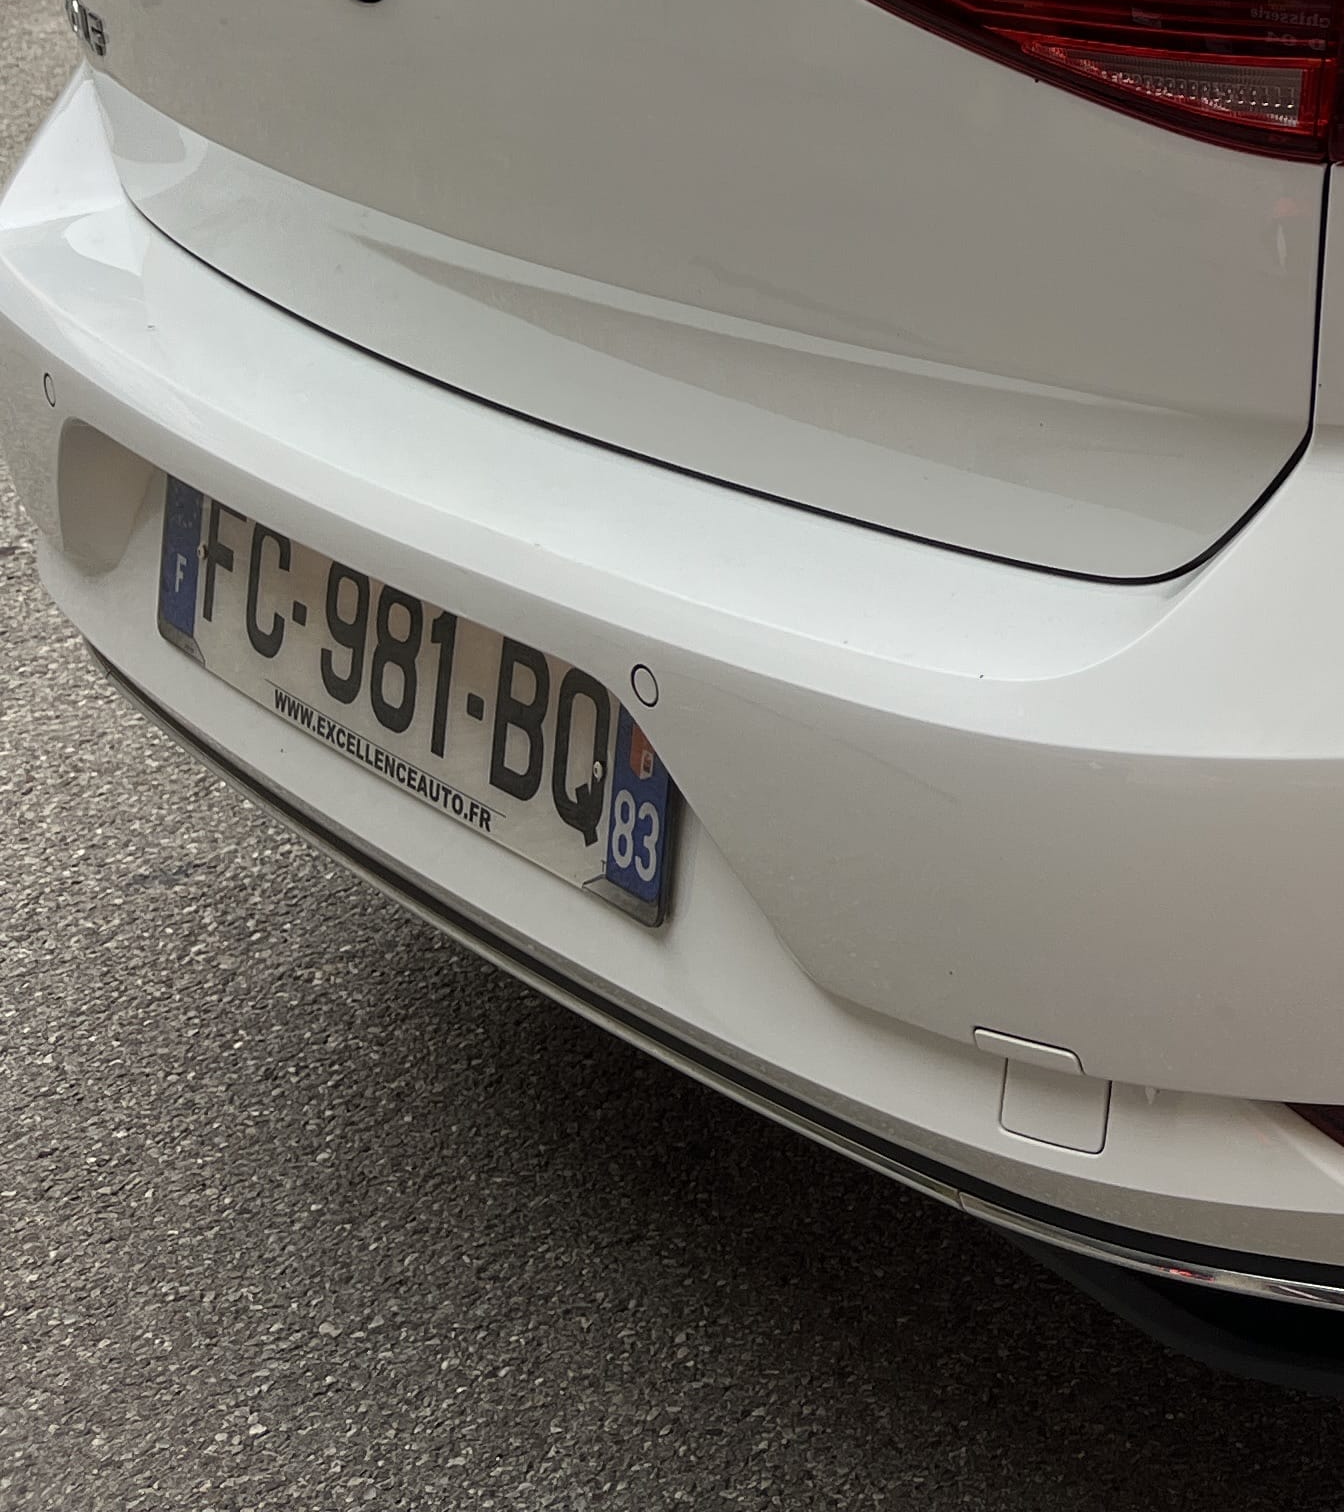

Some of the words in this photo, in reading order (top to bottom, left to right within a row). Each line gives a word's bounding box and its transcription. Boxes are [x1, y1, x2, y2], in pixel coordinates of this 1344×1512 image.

[173, 551, 188, 594] F
[203, 498, 612, 848] FC-981-BQ
[272, 688, 492, 833] WWW.EXCELLENCEAUTO.FR
[611, 789, 661, 882] 83
